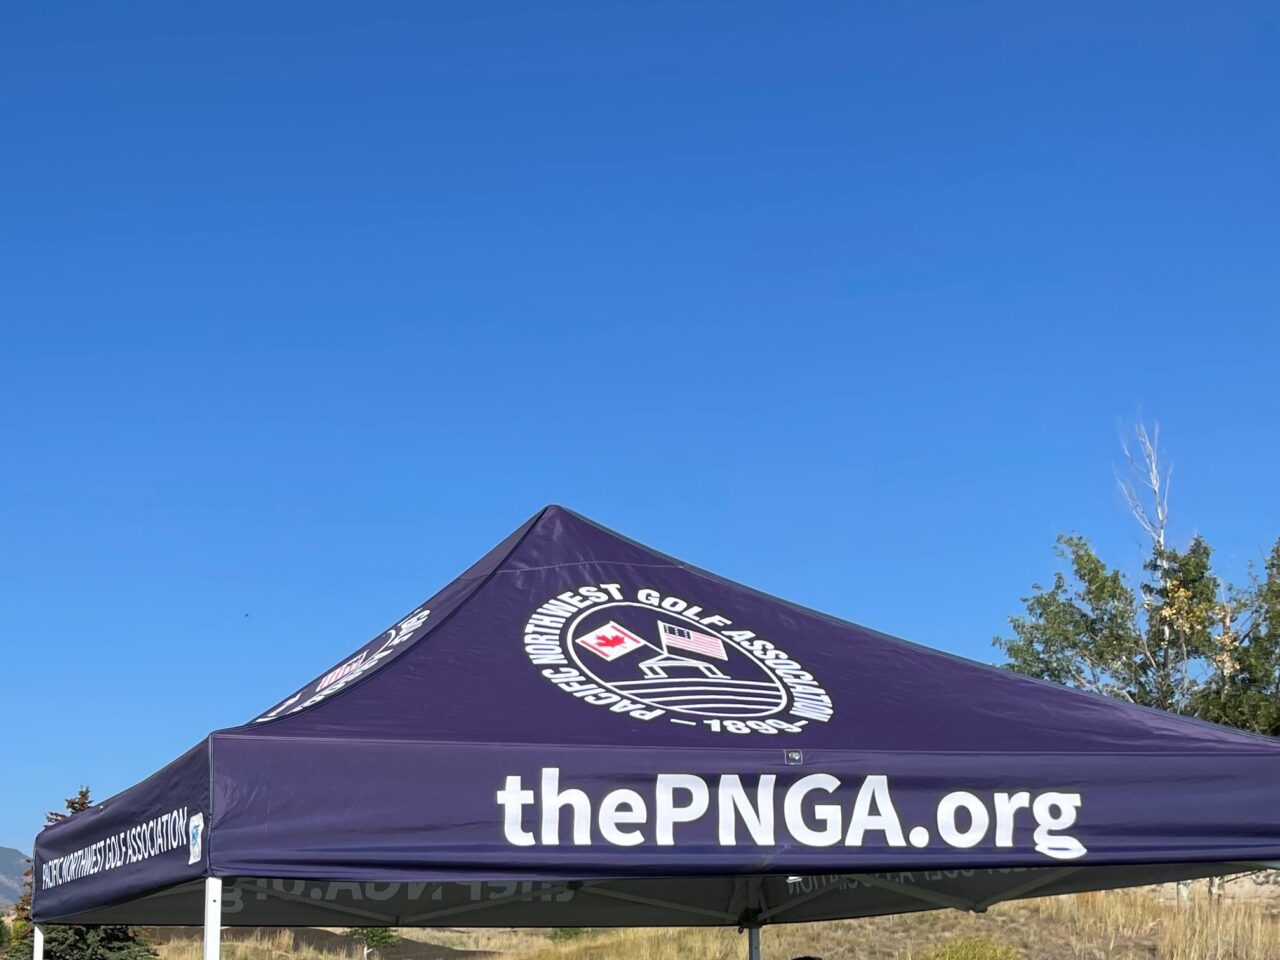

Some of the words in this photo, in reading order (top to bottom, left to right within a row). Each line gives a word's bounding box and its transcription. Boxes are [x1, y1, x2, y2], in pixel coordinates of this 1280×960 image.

[524, 583, 624, 665] NORTHWEST
[637, 588, 733, 627] GOLF
[541, 668, 666, 721] PACIFIC
[722, 630, 834, 722] ASSOCIATION
[42, 857, 63, 890] PACIFIC
[61, 840, 105, 882] NORTHWEST
[105, 832, 126, 871] GOLF
[125, 806, 188, 865] ASSOCIATION
[497, 768, 1087, 860] thePNGA.org
